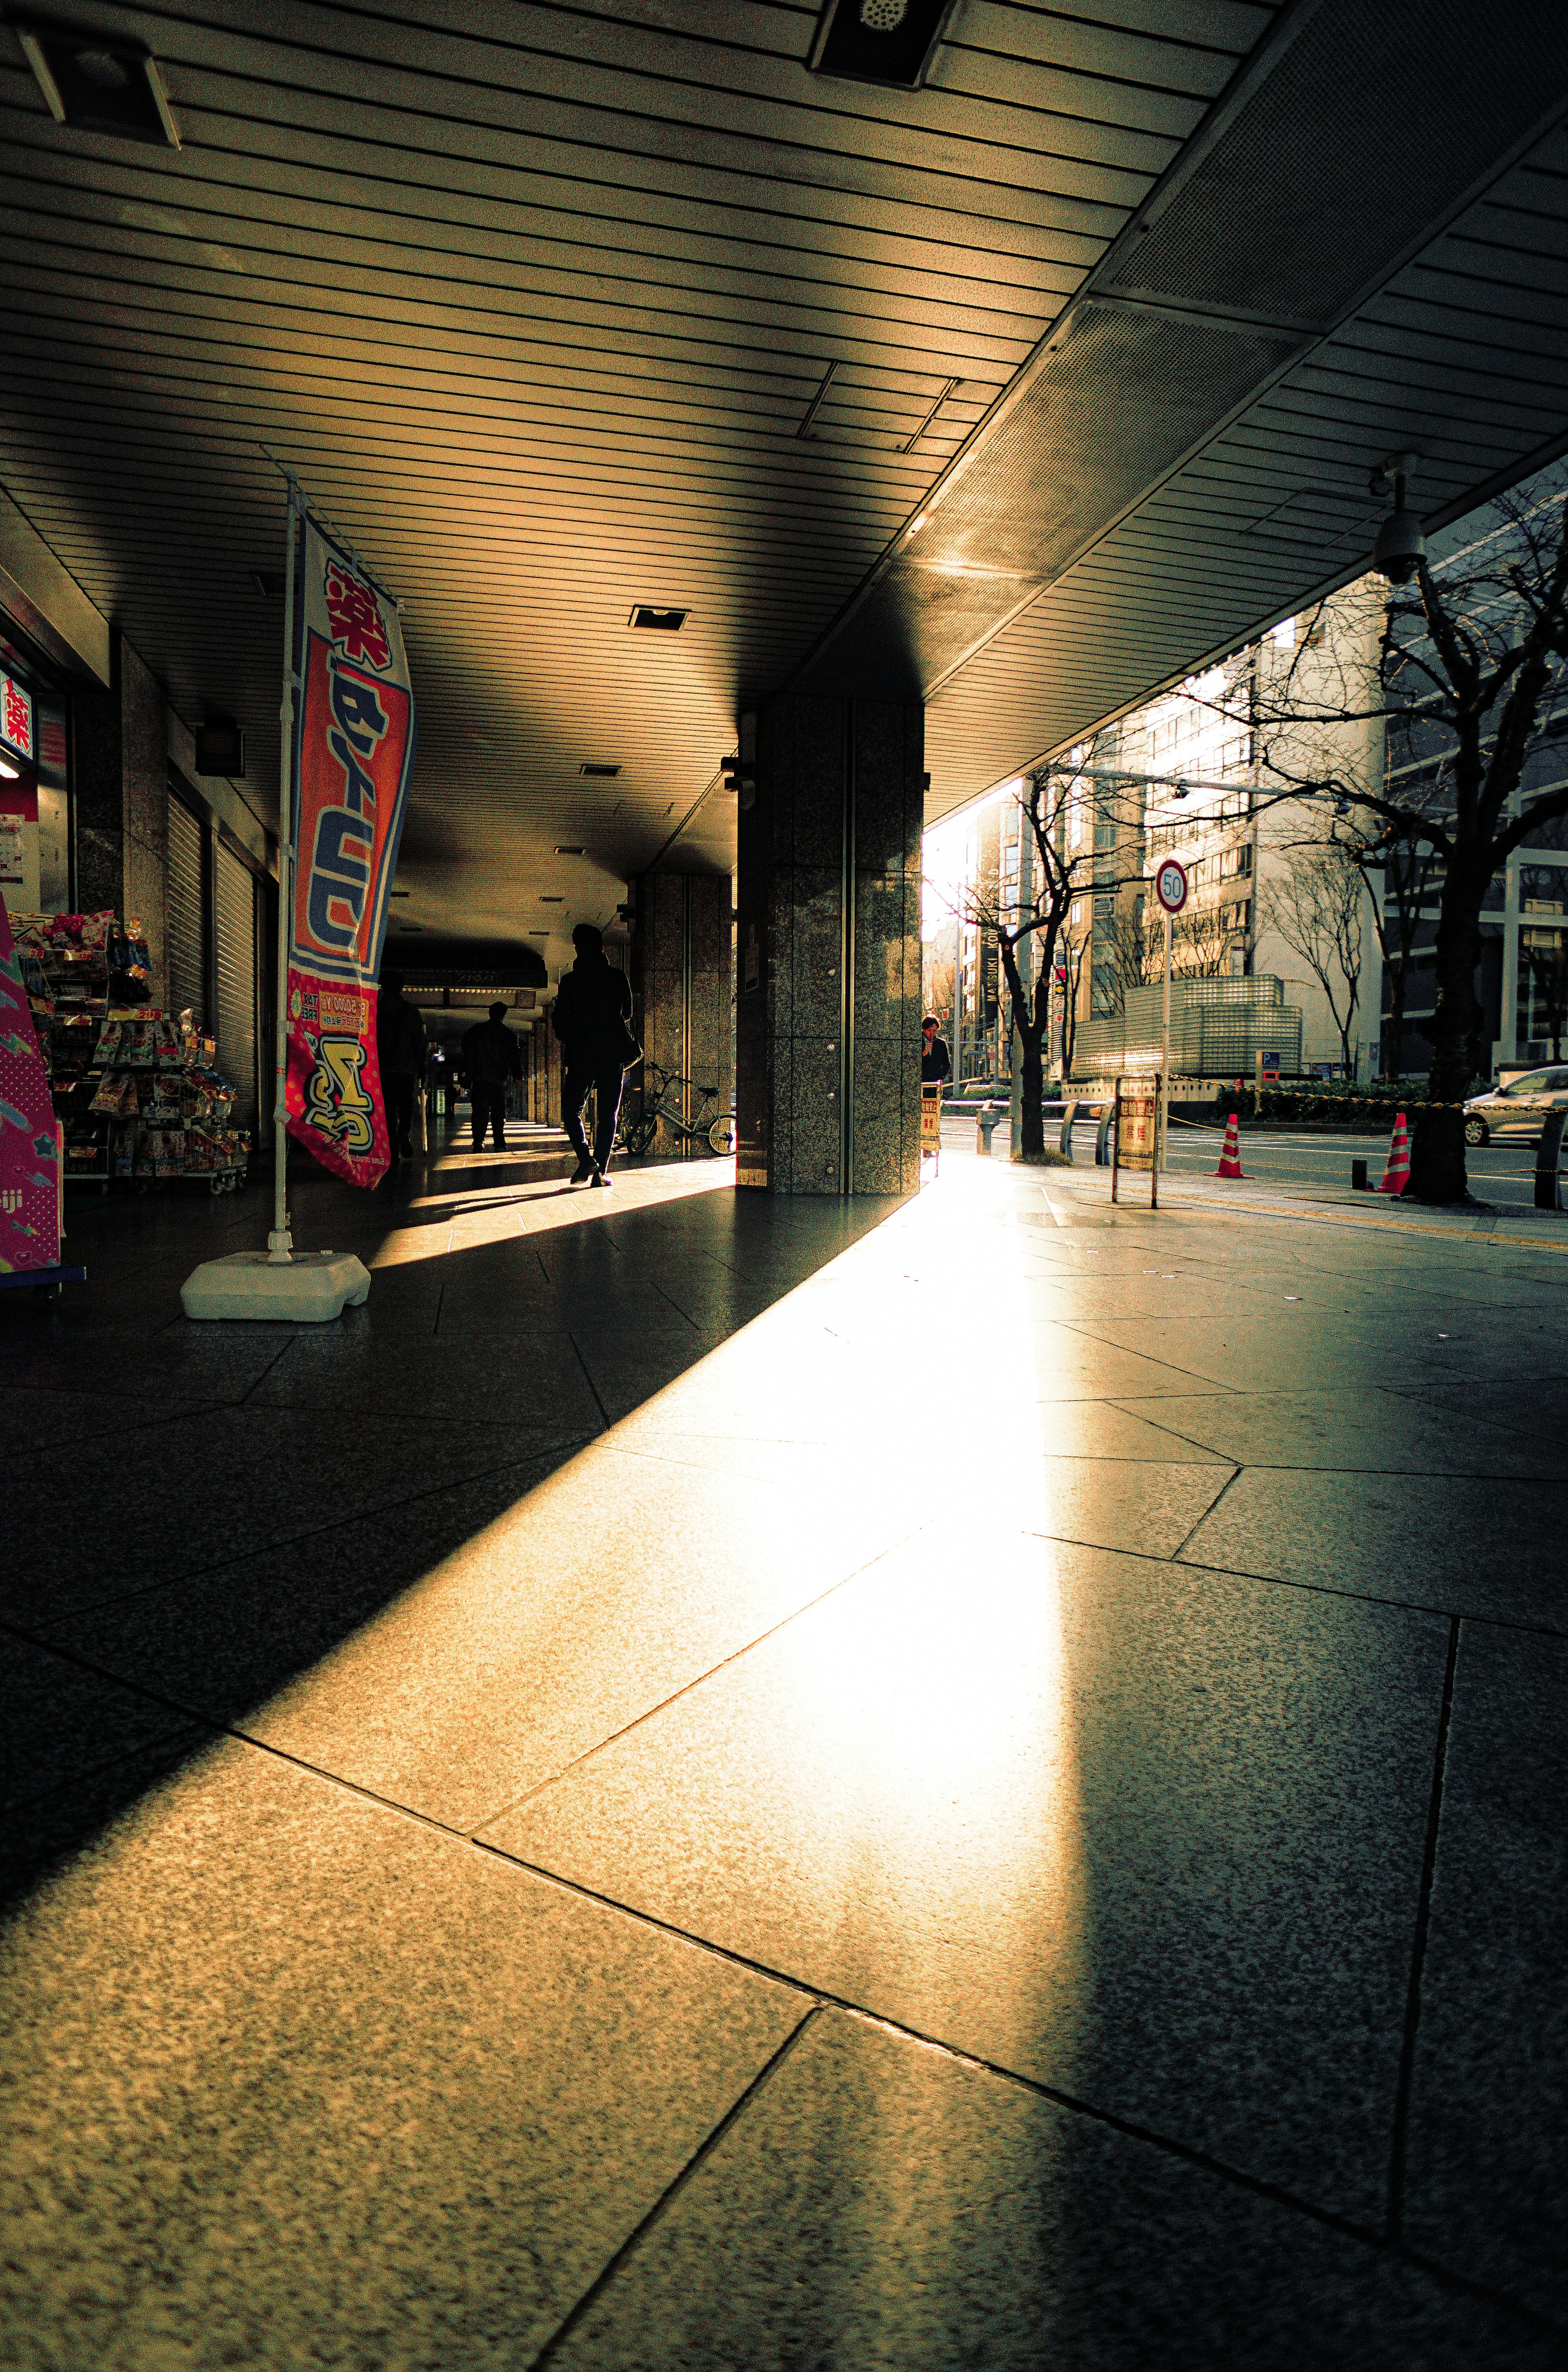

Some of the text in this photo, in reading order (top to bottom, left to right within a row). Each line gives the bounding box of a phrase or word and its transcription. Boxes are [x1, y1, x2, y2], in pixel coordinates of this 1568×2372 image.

[7, 680, 29, 751] 薬
[1164, 873, 1180, 898] 50
[987, 958, 998, 1001] MATSUKI
[1263, 1053, 1270, 1064] P
